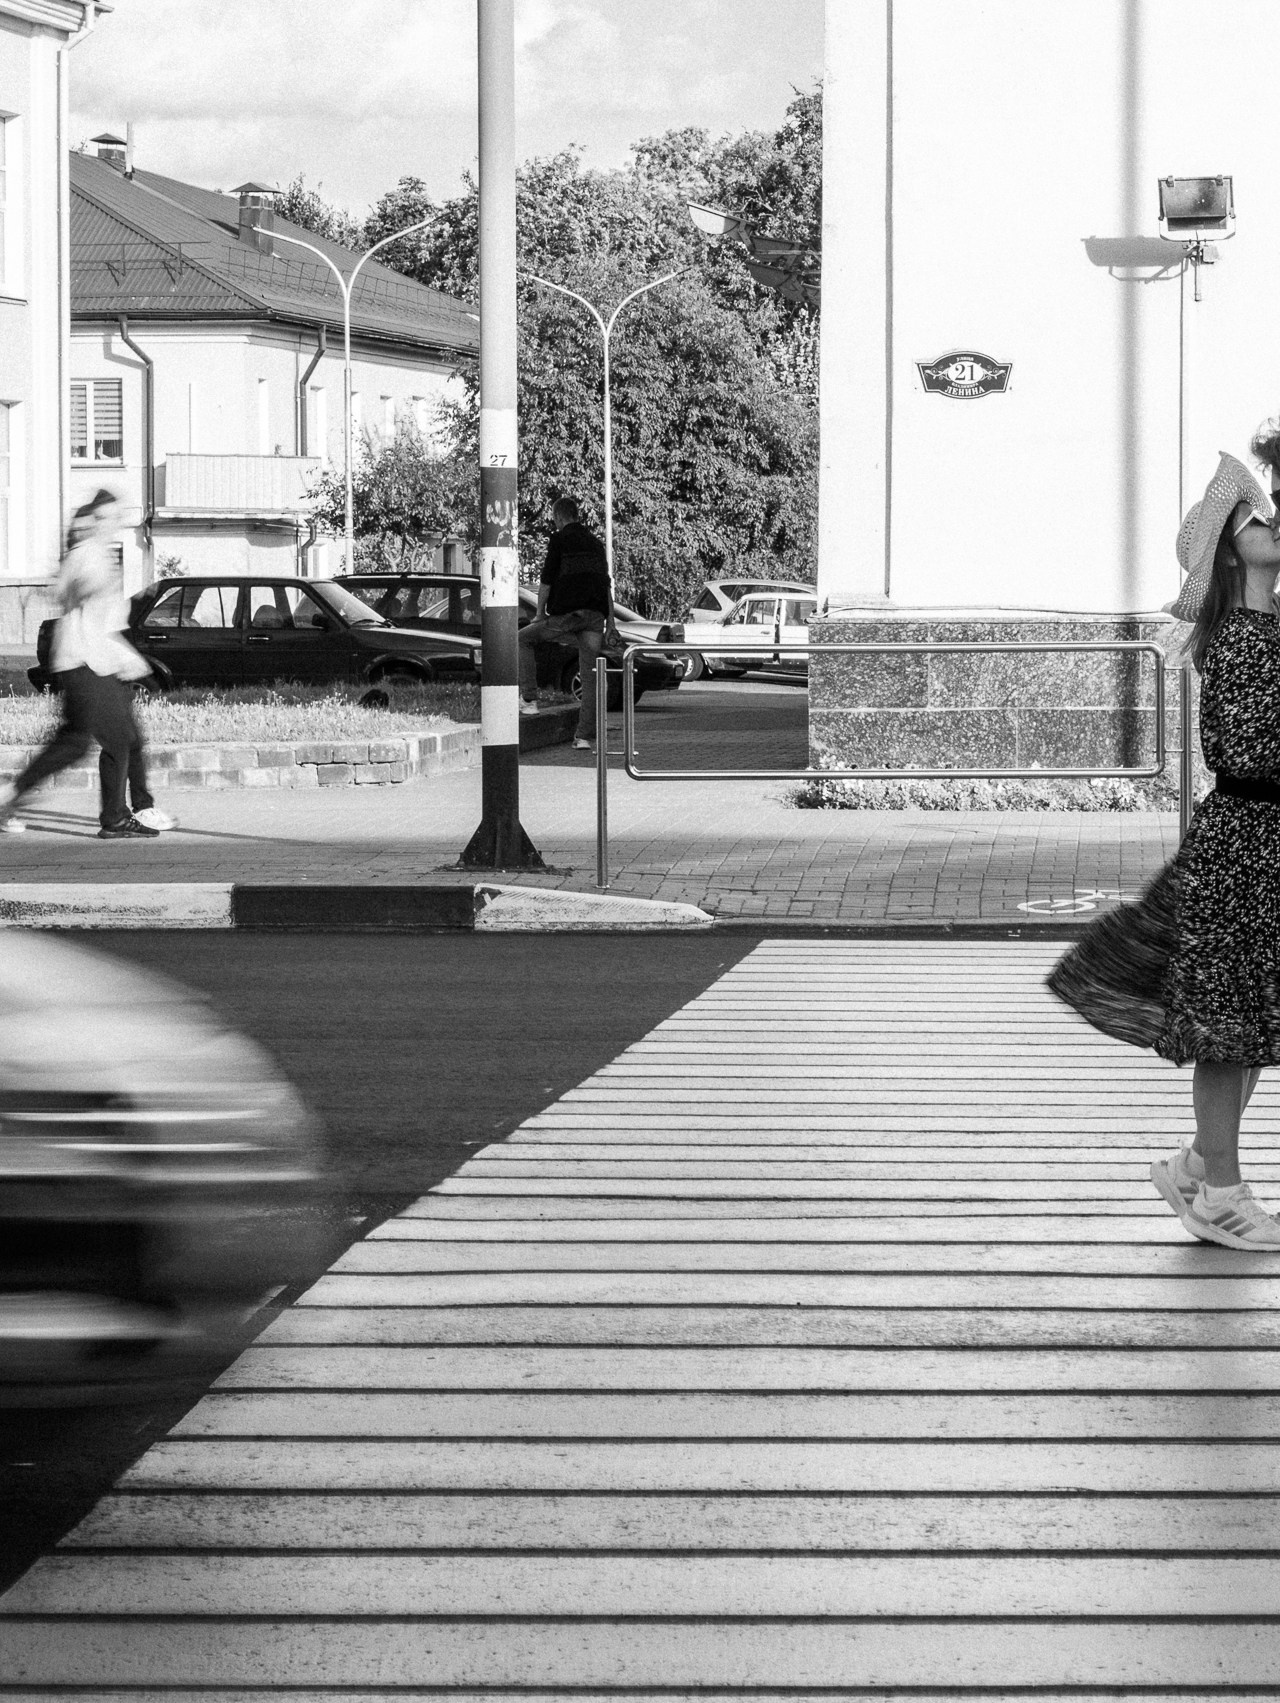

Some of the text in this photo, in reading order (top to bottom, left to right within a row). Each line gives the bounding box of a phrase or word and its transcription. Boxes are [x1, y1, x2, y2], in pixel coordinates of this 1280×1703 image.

[955, 364, 975, 381] 21
[945, 386, 985, 396] ЛЕНИНА
[490, 455, 507, 466] 27
